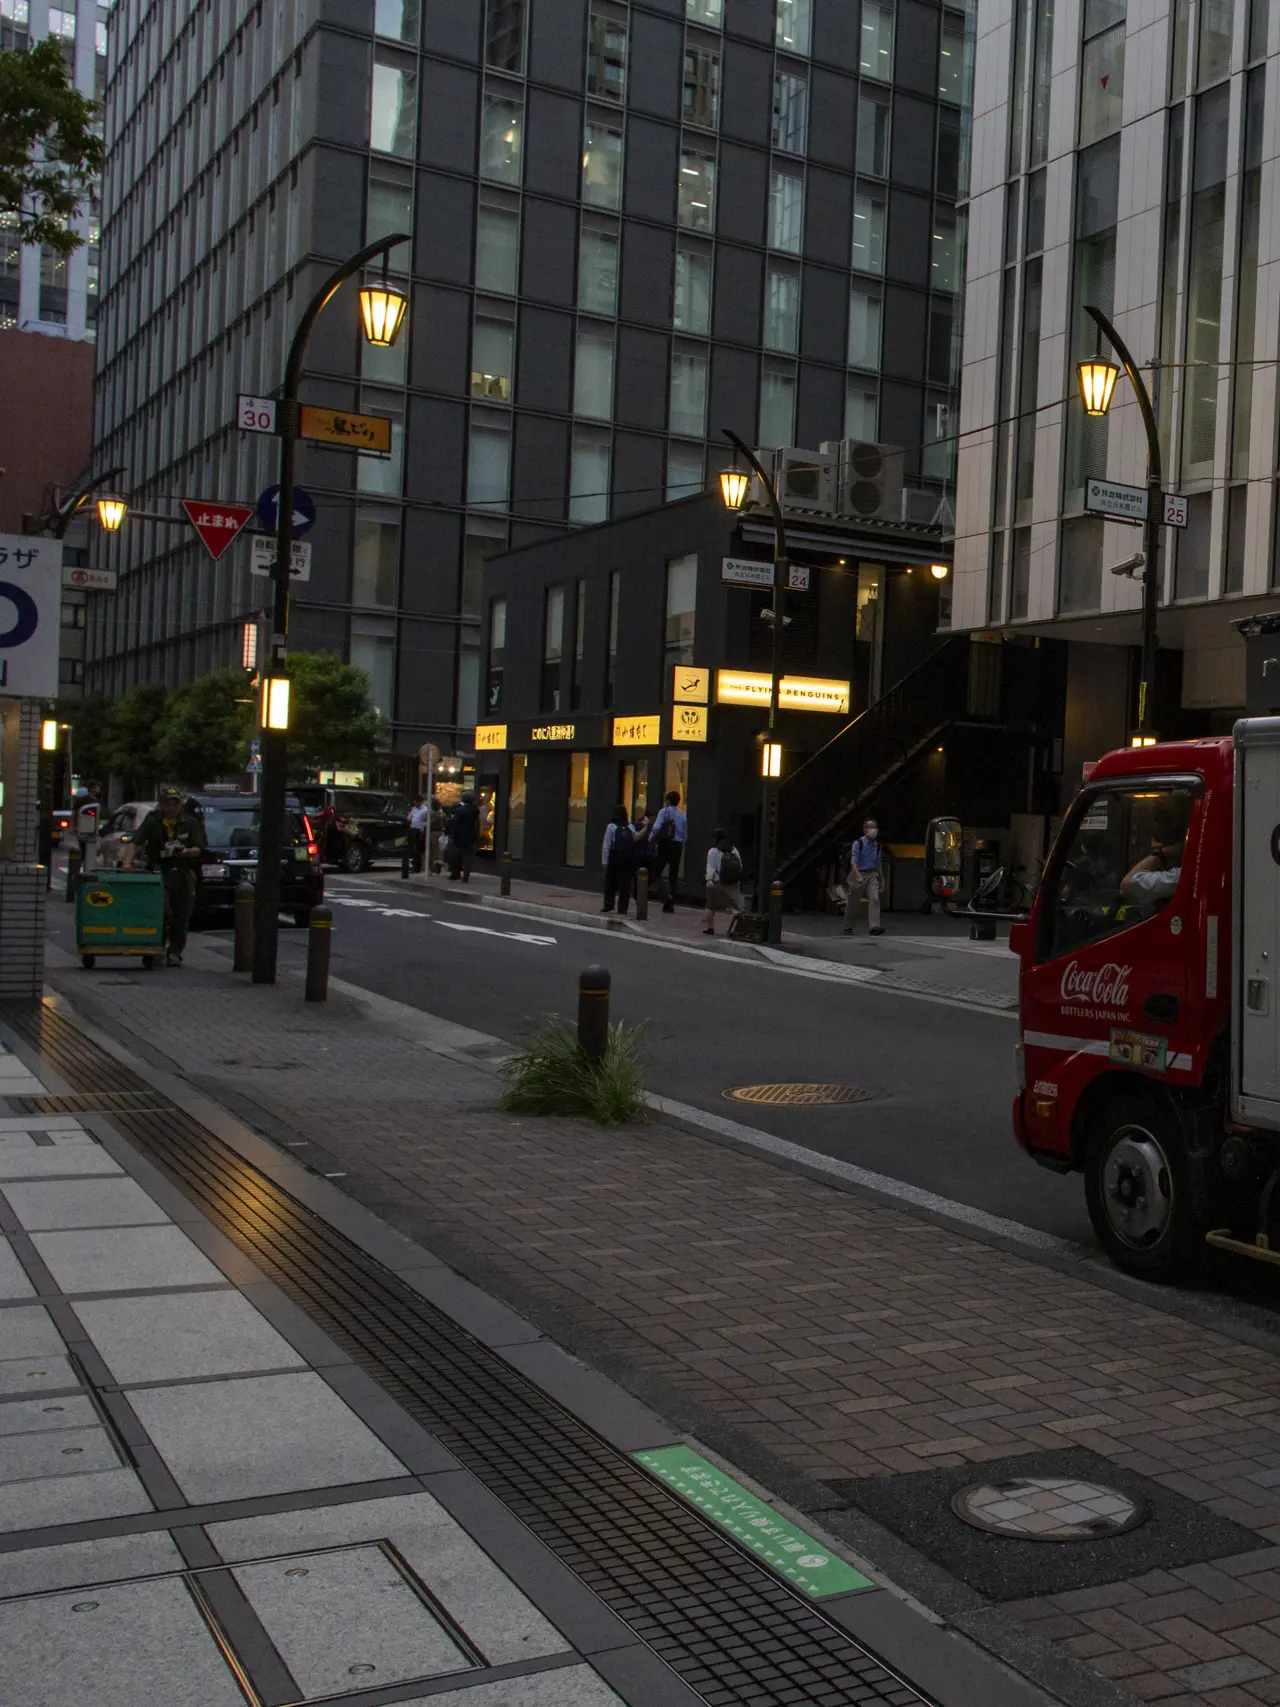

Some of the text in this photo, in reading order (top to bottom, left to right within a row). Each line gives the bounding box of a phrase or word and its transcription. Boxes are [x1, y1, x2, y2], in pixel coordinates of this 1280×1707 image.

[243, 411, 271, 429] 30
[196, 513, 239, 529] 止まれ
[1167, 508, 1184, 523] 25
[791, 575, 806, 586] 24
[745, 685, 781, 695] FLYIN
[786, 689, 840, 701] PENGUINS
[1061, 960, 1133, 1006] Coca-Cola
[1061, 1006, 1132, 1022] BOTTLERS JAPAN INC.
